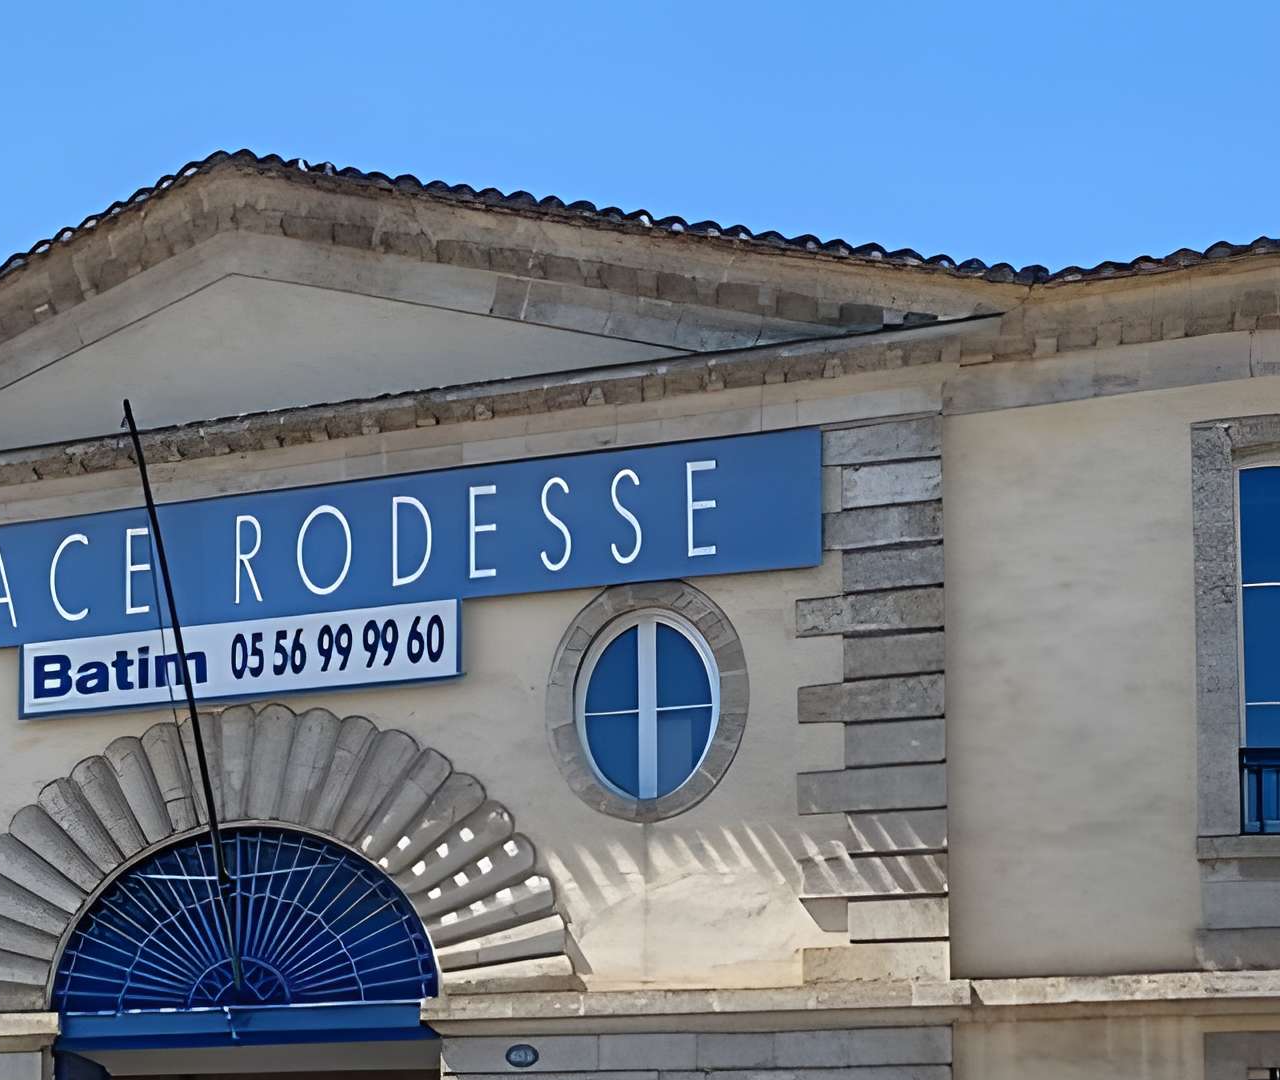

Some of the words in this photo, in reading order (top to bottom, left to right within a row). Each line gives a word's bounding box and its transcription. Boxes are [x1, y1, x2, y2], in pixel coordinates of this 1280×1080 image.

[235, 459, 717, 603] RODESSE
[33, 646, 208, 699] Batim
[231, 632, 264, 679] 05
[273, 628, 307, 675] 56
[317, 623, 352, 672] 99
[362, 618, 399, 668] 99
[406, 614, 445, 664] 60
